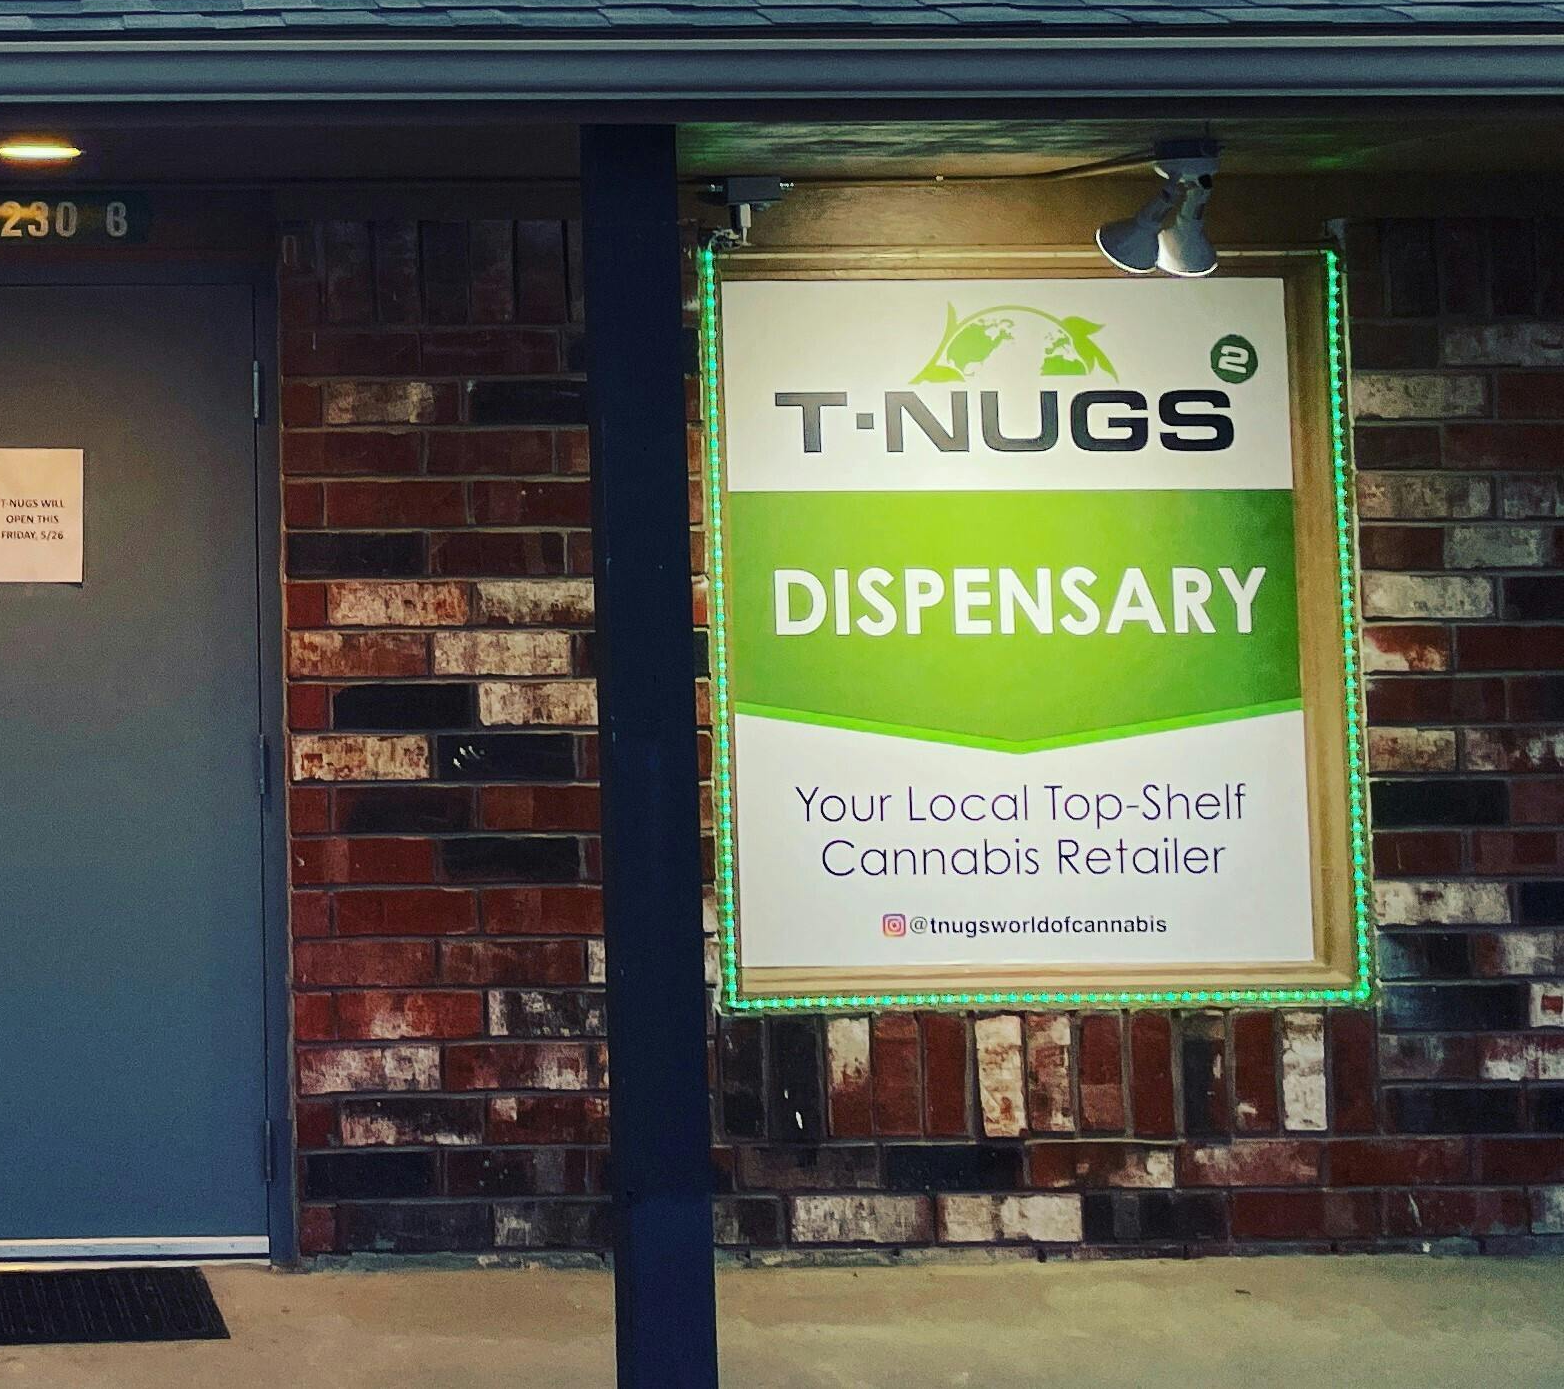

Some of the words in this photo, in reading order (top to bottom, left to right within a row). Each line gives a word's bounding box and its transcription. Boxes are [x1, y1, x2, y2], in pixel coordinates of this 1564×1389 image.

[1217, 345, 1249, 374] 2
[41, 498, 65, 508] WILL
[6, 515, 34, 524] OPEN
[37, 515, 59, 524] THIS
[1, 530, 38, 541] FRIDAY,
[40, 530, 64, 541] 5/26
[773, 566, 1267, 636] DISPENSARY
[795, 785, 892, 822] Your
[908, 784, 1028, 822] Local
[1044, 783, 1246, 829] Top-Shelf
[821, 838, 1040, 876] Cannabis
[1058, 837, 1227, 875] Retailer
[909, 915, 1168, 938] @tnugsworldofcannabis
